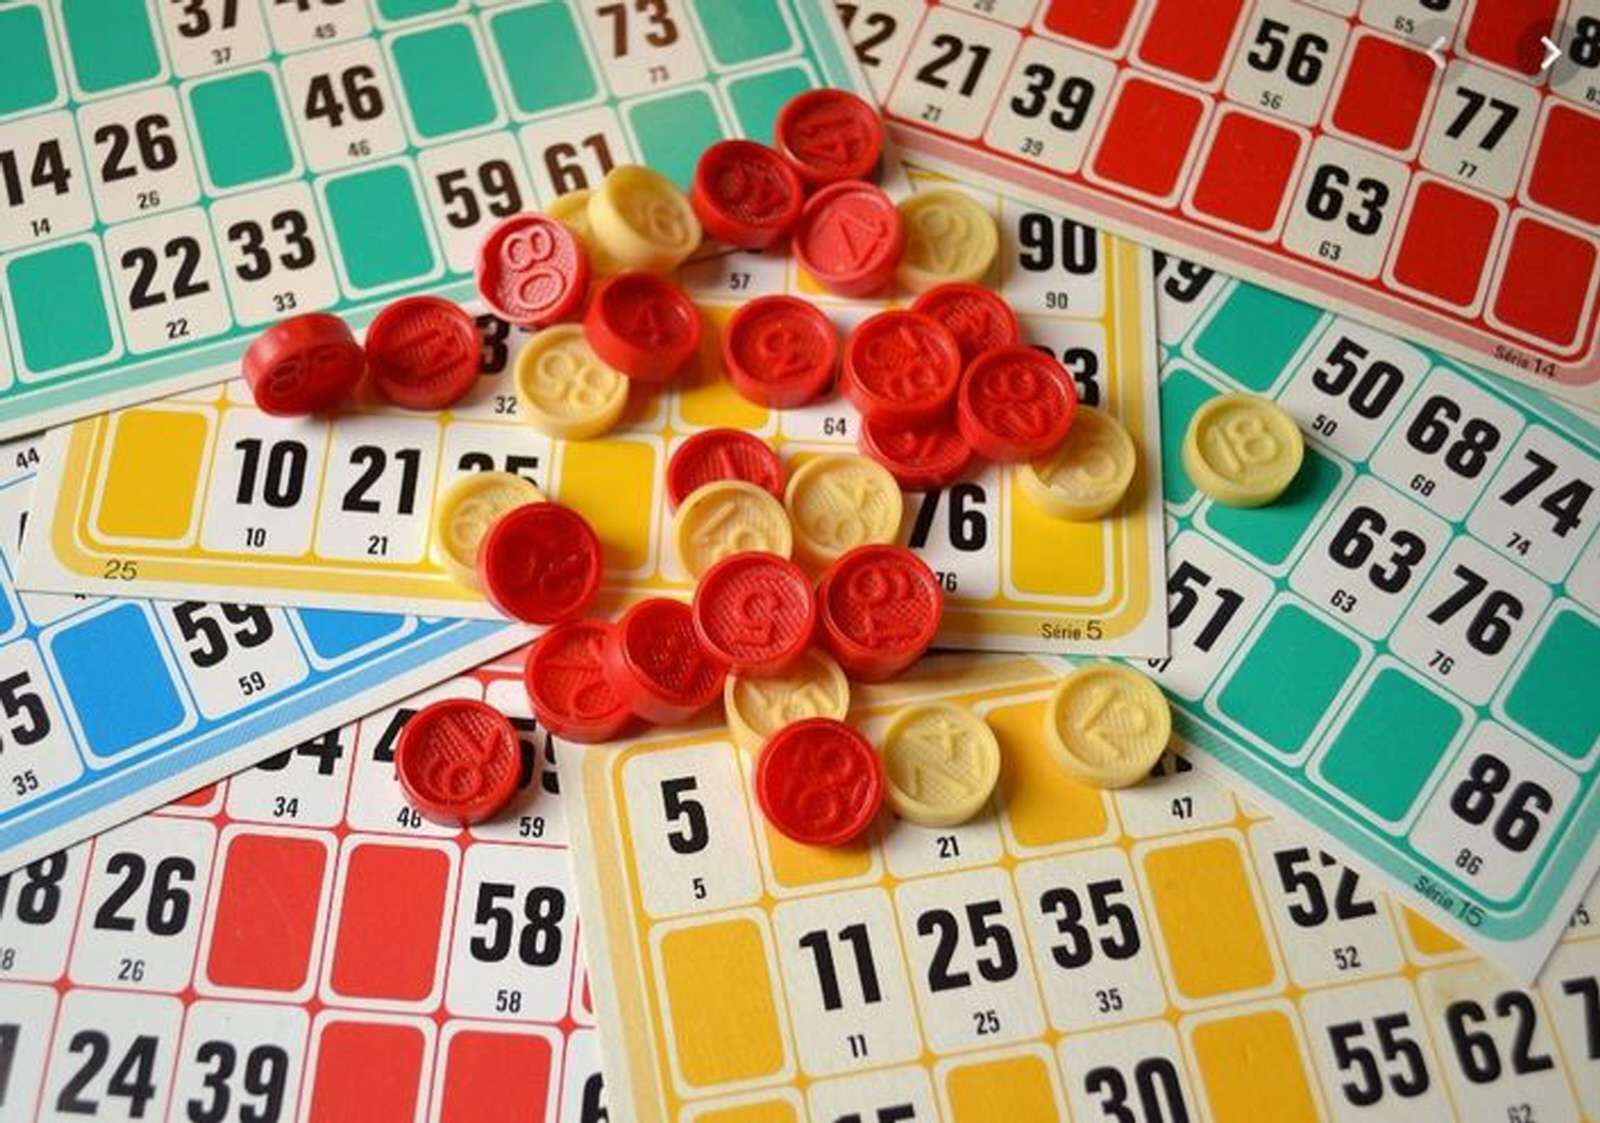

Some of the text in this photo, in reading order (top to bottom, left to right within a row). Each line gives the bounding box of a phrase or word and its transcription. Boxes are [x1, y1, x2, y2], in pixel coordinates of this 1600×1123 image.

[597, 0, 678, 58] 73
[212, 47, 231, 65] 37
[1248, 18, 1328, 86] 56
[916, 34, 991, 97] 21
[305, 66, 384, 127] 46
[1011, 64, 1095, 131] 39
[1260, 91, 1282, 109] 56
[921, 104, 942, 122] 21
[1446, 87, 1519, 151] 77
[95, 114, 177, 182] 26
[348, 140, 370, 156] 46
[1020, 138, 1044, 158] 39
[0, 139, 71, 206] 14
[1459, 161, 1477, 178] 77
[137, 191, 160, 210] 26
[436, 160, 522, 228] 59
[1306, 164, 1389, 235] 63
[31, 218, 50, 236] 14
[228, 210, 315, 281] 33
[1019, 213, 1096, 274] 90
[1319, 241, 1341, 261] 63
[122, 237, 209, 310] 22
[730, 273, 752, 289] 57
[273, 292, 296, 312] 33
[1046, 291, 1068, 309] 90
[166, 318, 189, 339] 22
[1312, 337, 1404, 419] 50
[1532, 359, 1557, 378] 14
[491, 392, 517, 414] 32
[824, 417, 846, 435] 64
[1308, 414, 1337, 440] 50
[1407, 396, 1500, 478] 68
[1208, 416, 1276, 473] 18
[16, 448, 39, 468] 44
[236, 439, 307, 508] 10
[342, 446, 420, 514] 21
[1410, 474, 1435, 497] 68
[1500, 450, 1594, 537] 74
[247, 528, 266, 547] 10
[368, 536, 387, 555] 21
[1507, 532, 1531, 556] 74
[1329, 507, 1426, 594] 63
[104, 560, 137, 581] 25
[1331, 590, 1357, 613] 63
[1427, 565, 1523, 655] 76
[1042, 621, 1102, 641] Série 5
[1429, 650, 1454, 675] 76
[239, 672, 265, 695] 59
[12, 770, 38, 795] 35
[274, 796, 298, 817] 34
[661, 777, 709, 854] 5
[1172, 797, 1192, 819] 47
[1451, 754, 1553, 852] 86
[516, 813, 544, 838] 59
[937, 836, 959, 858] 21
[1456, 848, 1483, 875] 86
[94, 853, 195, 936] 26
[693, 878, 706, 899] 5
[1274, 847, 1377, 928] 52
[470, 882, 565, 967] 58
[1040, 879, 1140, 969] 35
[1458, 902, 1485, 928] 15
[917, 900, 1018, 992] 25
[1334, 946, 1361, 970] 52
[118, 959, 145, 982] 26
[799, 924, 881, 1010] 11
[496, 990, 521, 1013] 58
[1096, 988, 1122, 1013] 35
[974, 1010, 1000, 1035] 25
[848, 1034, 867, 1058] 11
[1446, 991, 1554, 1084] 62
[1328, 1013, 1430, 1106] 55
[56, 1030, 158, 1118] 24
[187, 1041, 288, 1123] 39
